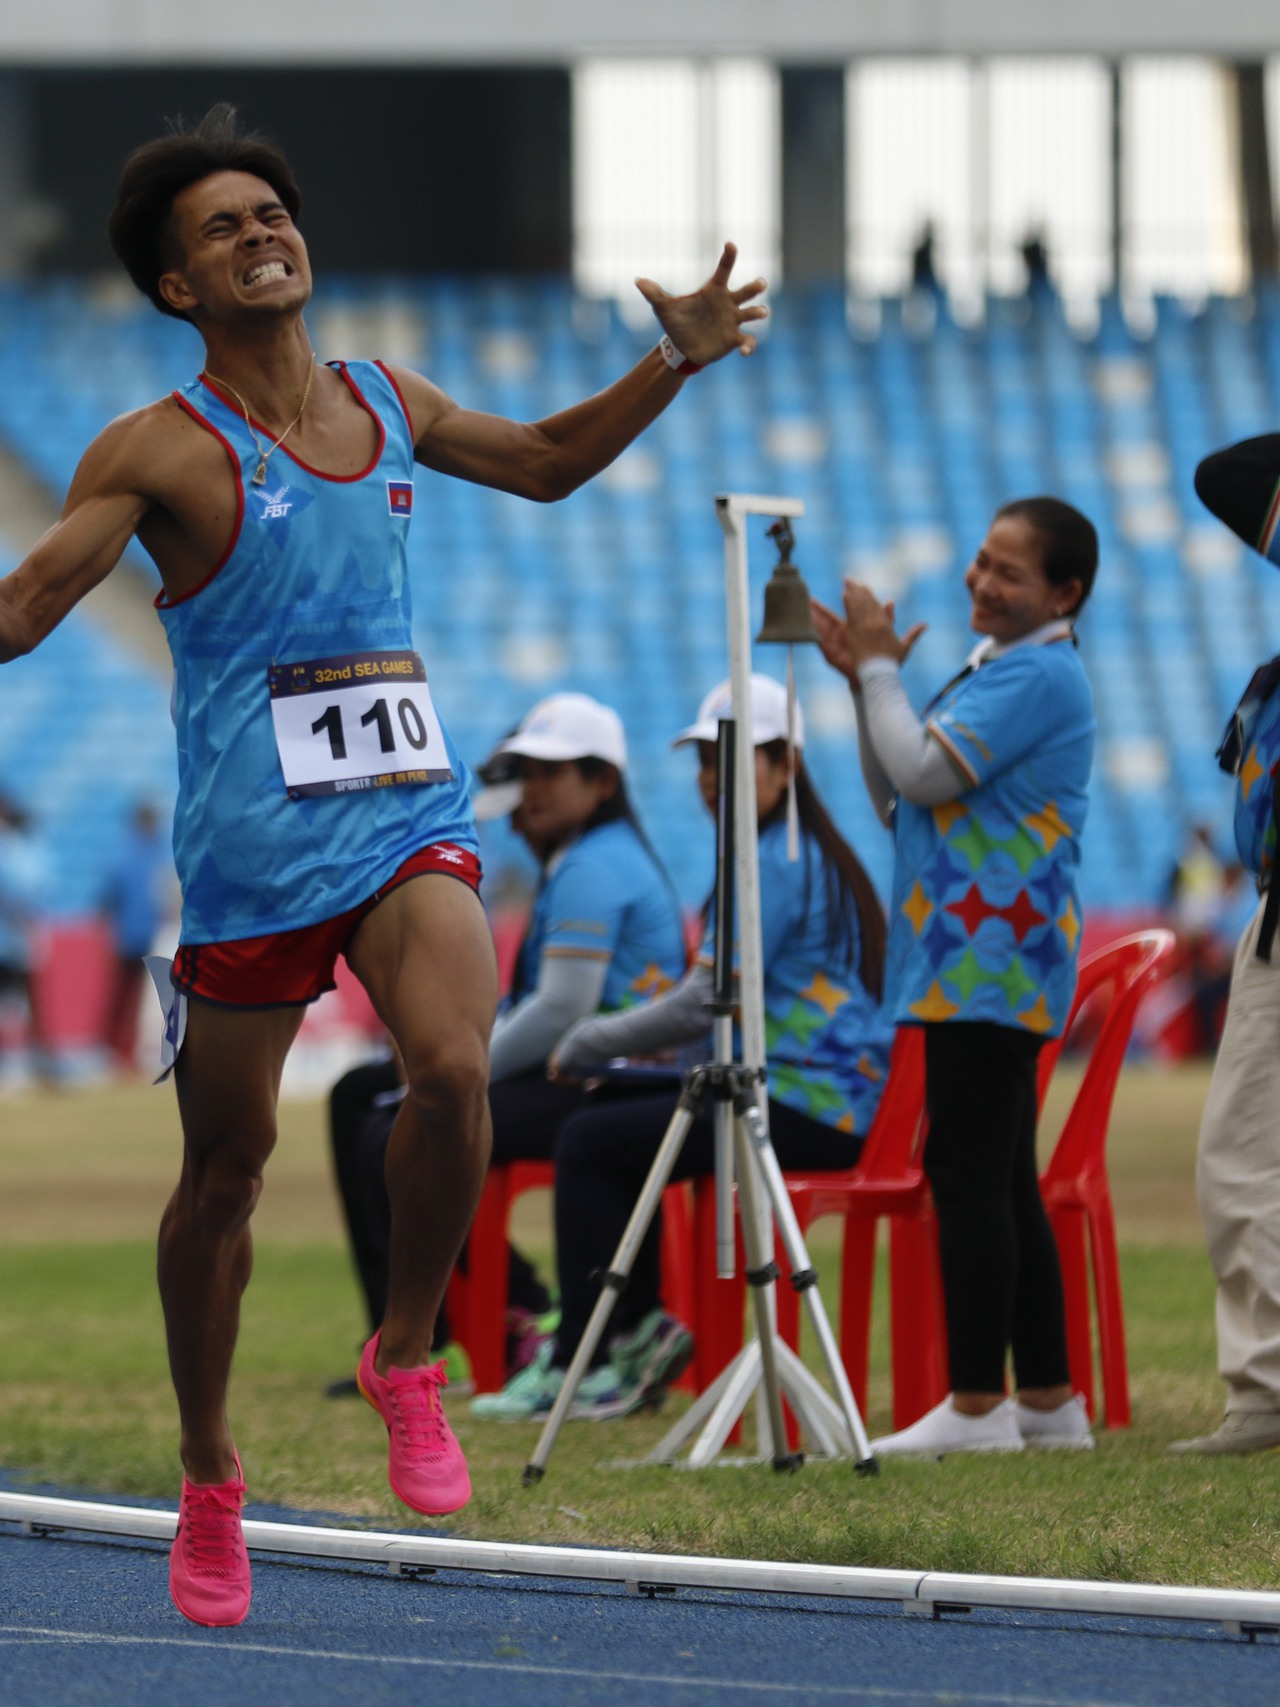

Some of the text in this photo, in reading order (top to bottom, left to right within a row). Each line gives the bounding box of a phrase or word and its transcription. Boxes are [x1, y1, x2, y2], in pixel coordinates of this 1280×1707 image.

[260, 503, 293, 519] FBT
[314, 660, 414, 684] 32nd SEA GAMES
[311, 697, 428, 761] 110
[335, 777, 371, 792] SPORTS
